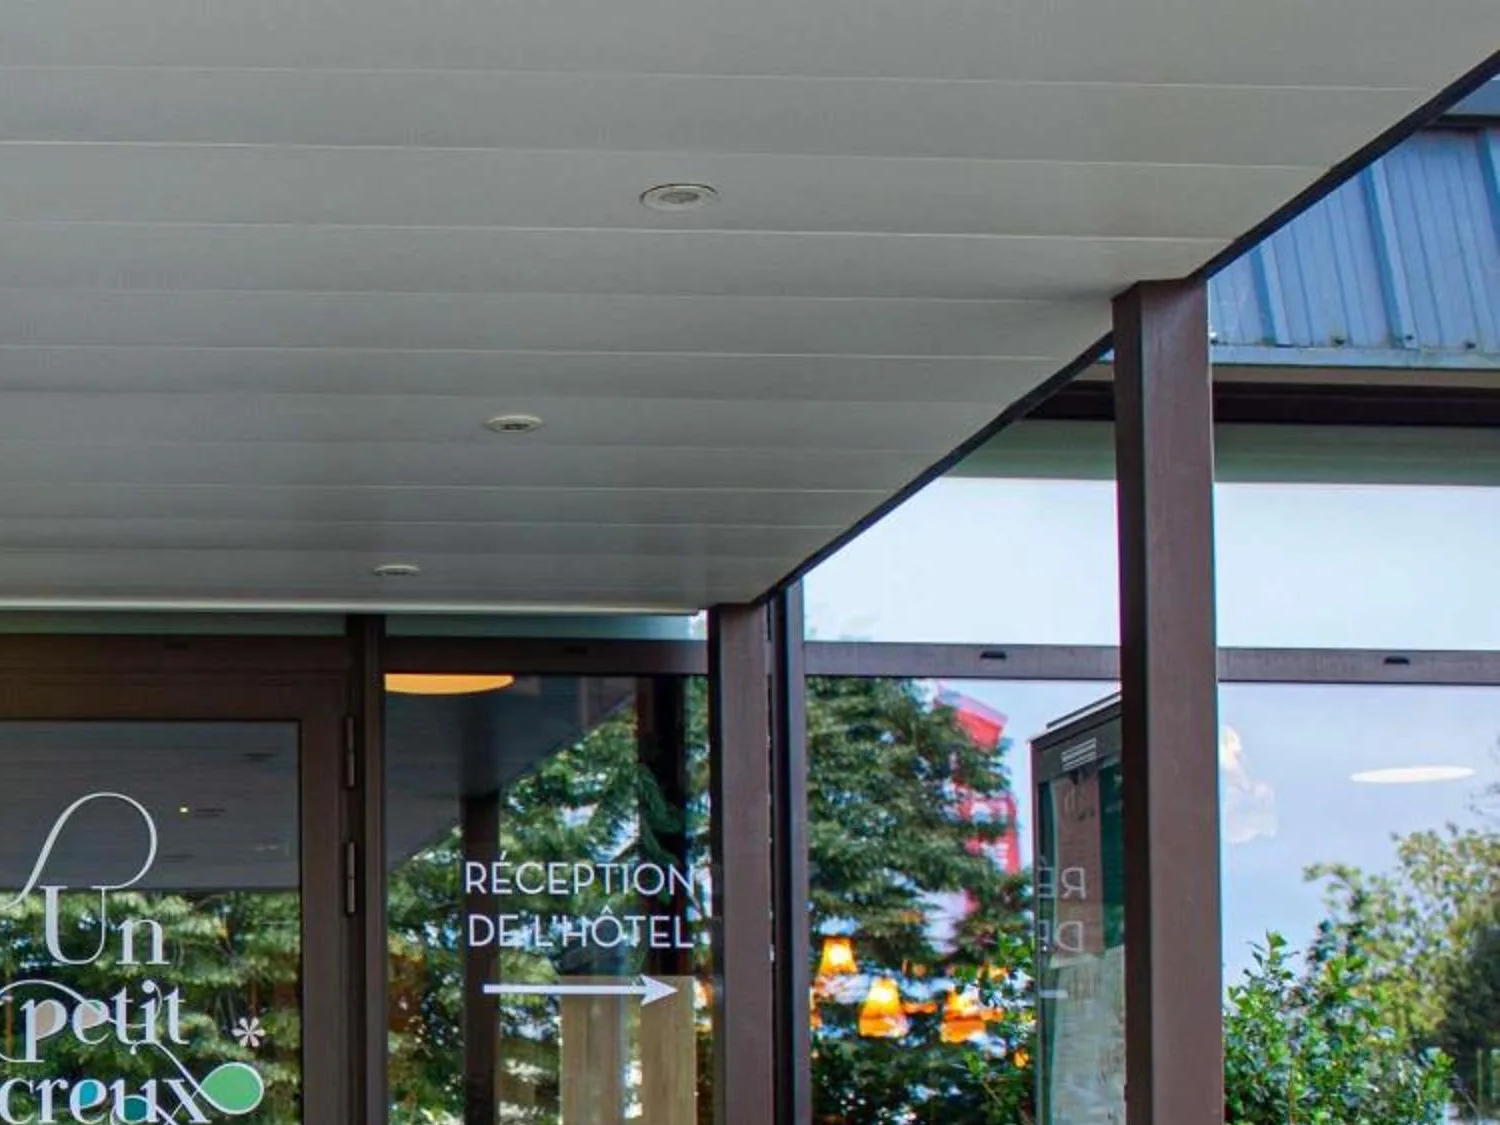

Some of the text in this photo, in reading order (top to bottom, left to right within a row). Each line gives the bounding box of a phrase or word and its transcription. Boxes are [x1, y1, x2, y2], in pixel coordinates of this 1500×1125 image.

[464, 851, 695, 896] RÉCEPTION
[468, 904, 695, 949] DE L'HÔTEL
